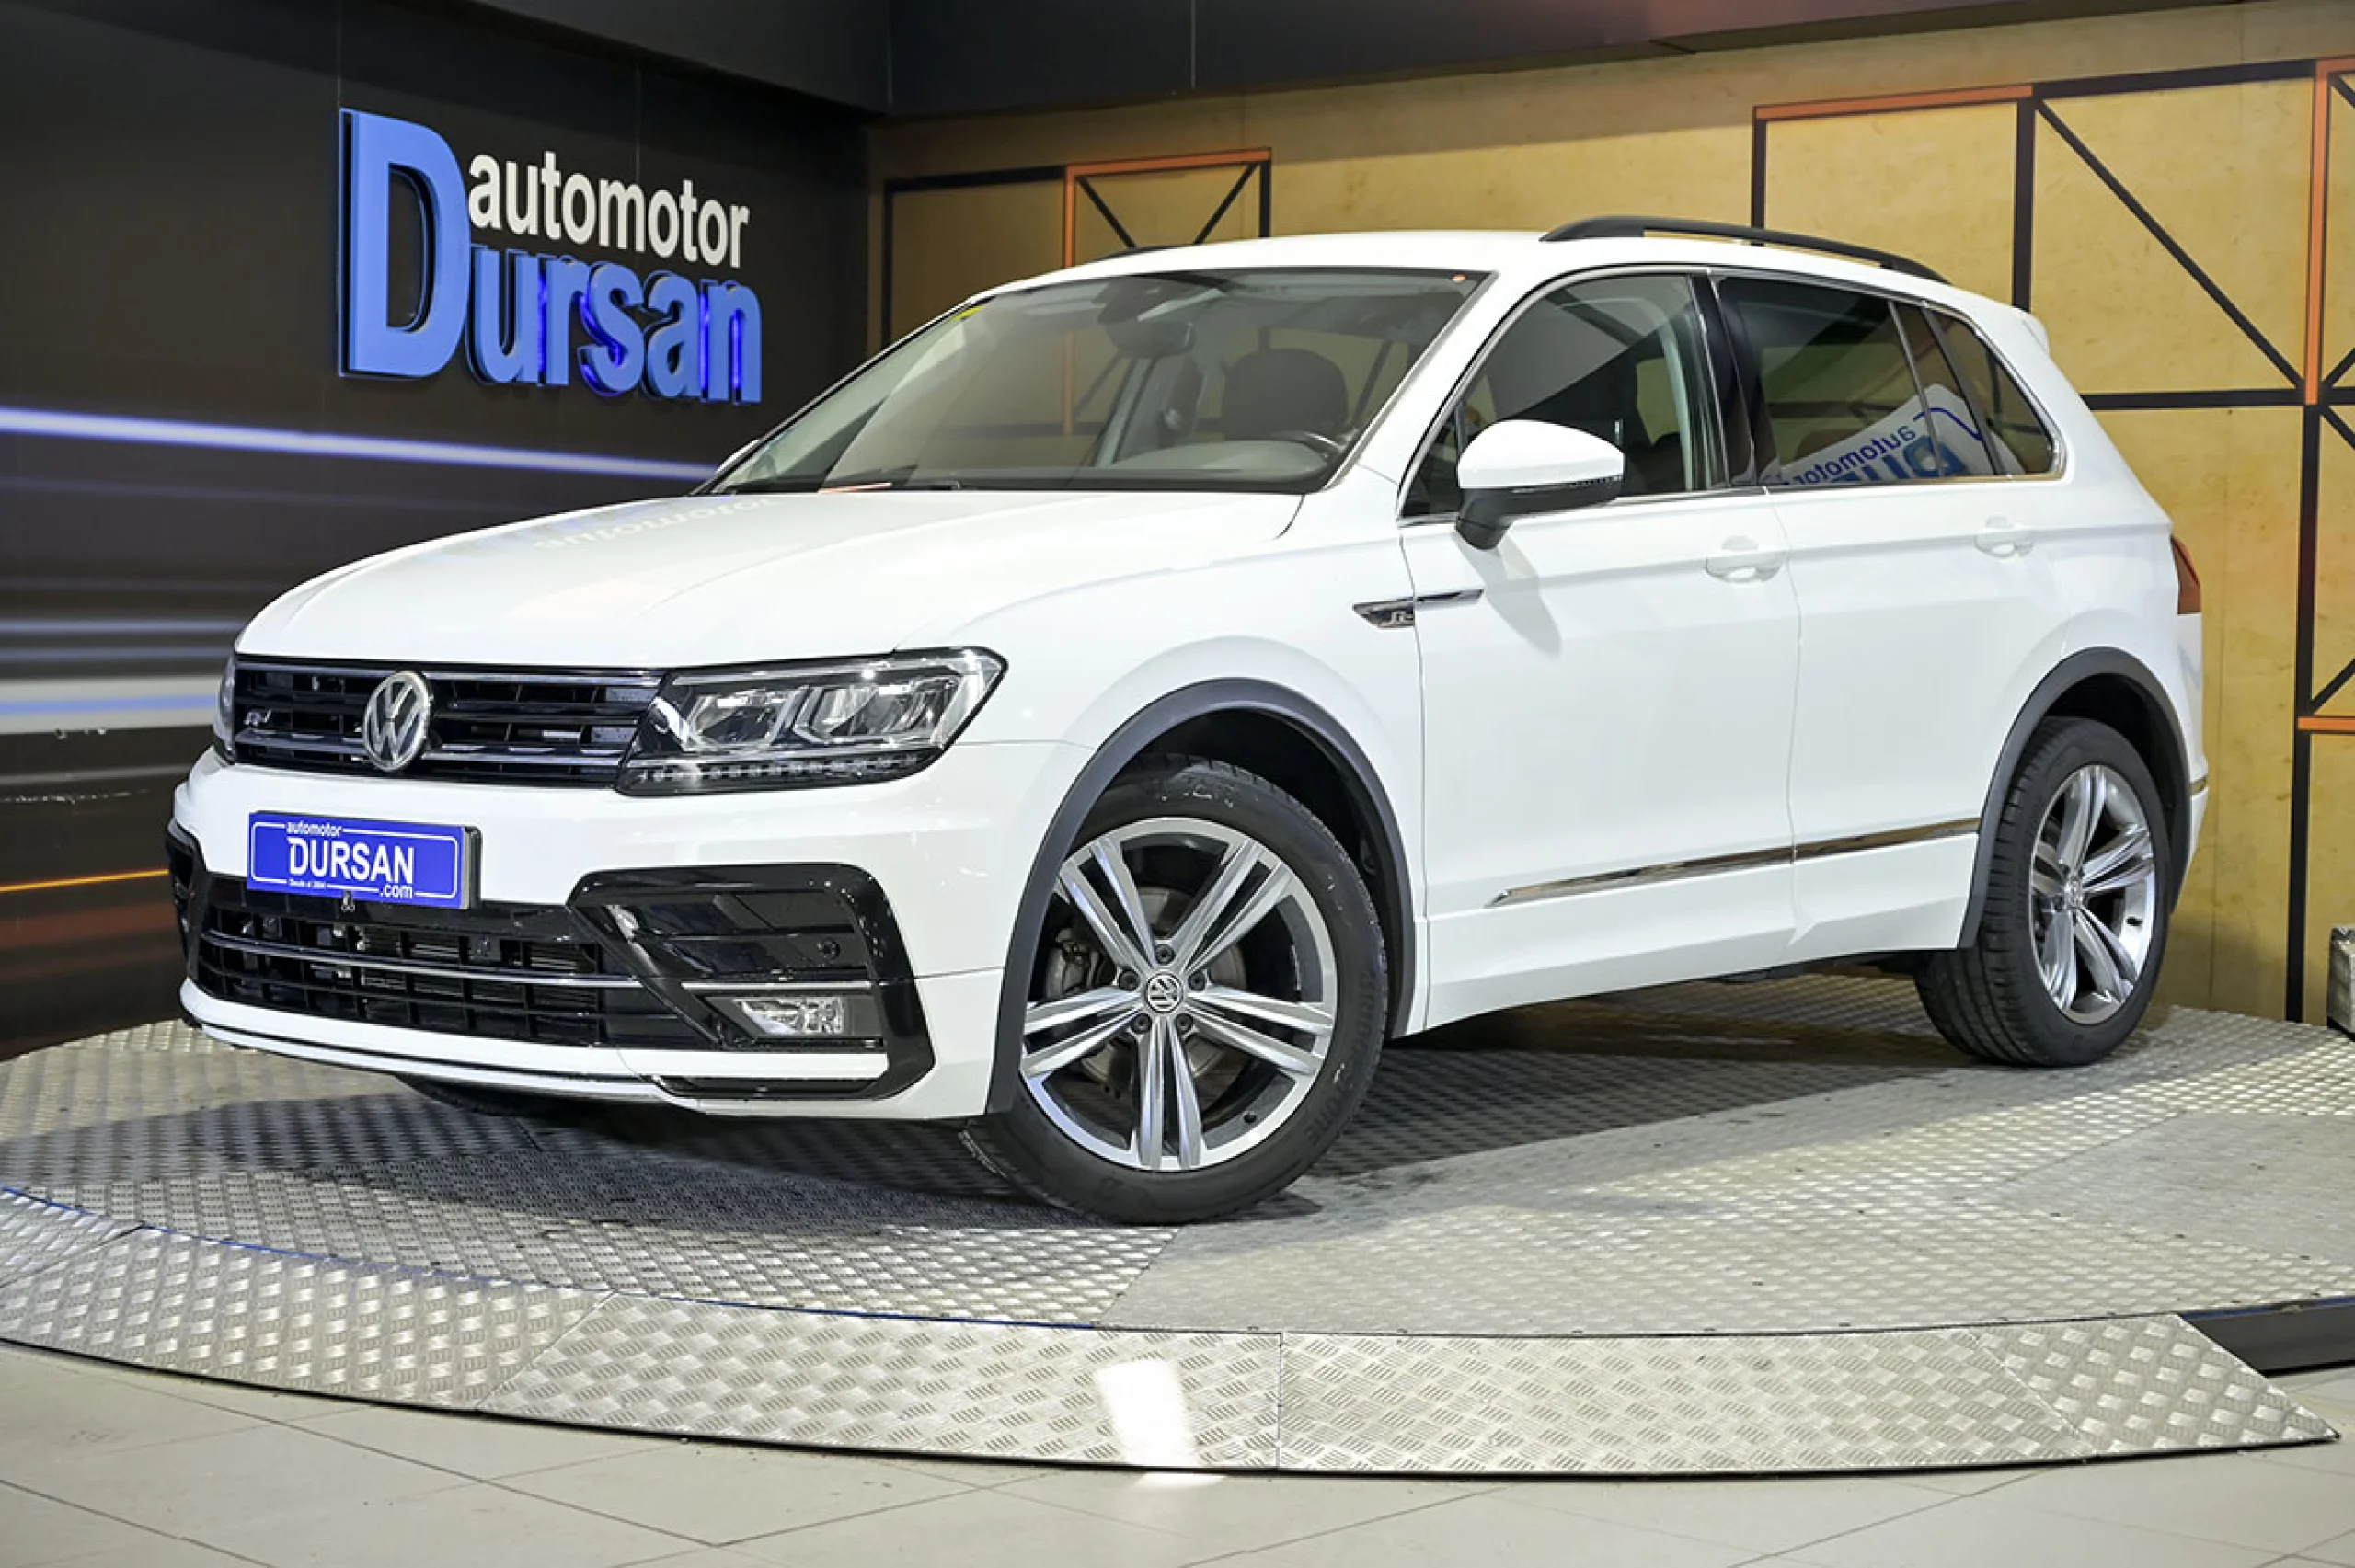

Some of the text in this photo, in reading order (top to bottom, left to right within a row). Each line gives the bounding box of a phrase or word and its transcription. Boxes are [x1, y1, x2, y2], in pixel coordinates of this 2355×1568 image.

[339, 107, 763, 405] Dursan
[468, 150, 750, 268] automotor
[364, 670, 431, 772] VW
[286, 837, 414, 884] DURSAN
[380, 884, 414, 899] .com
